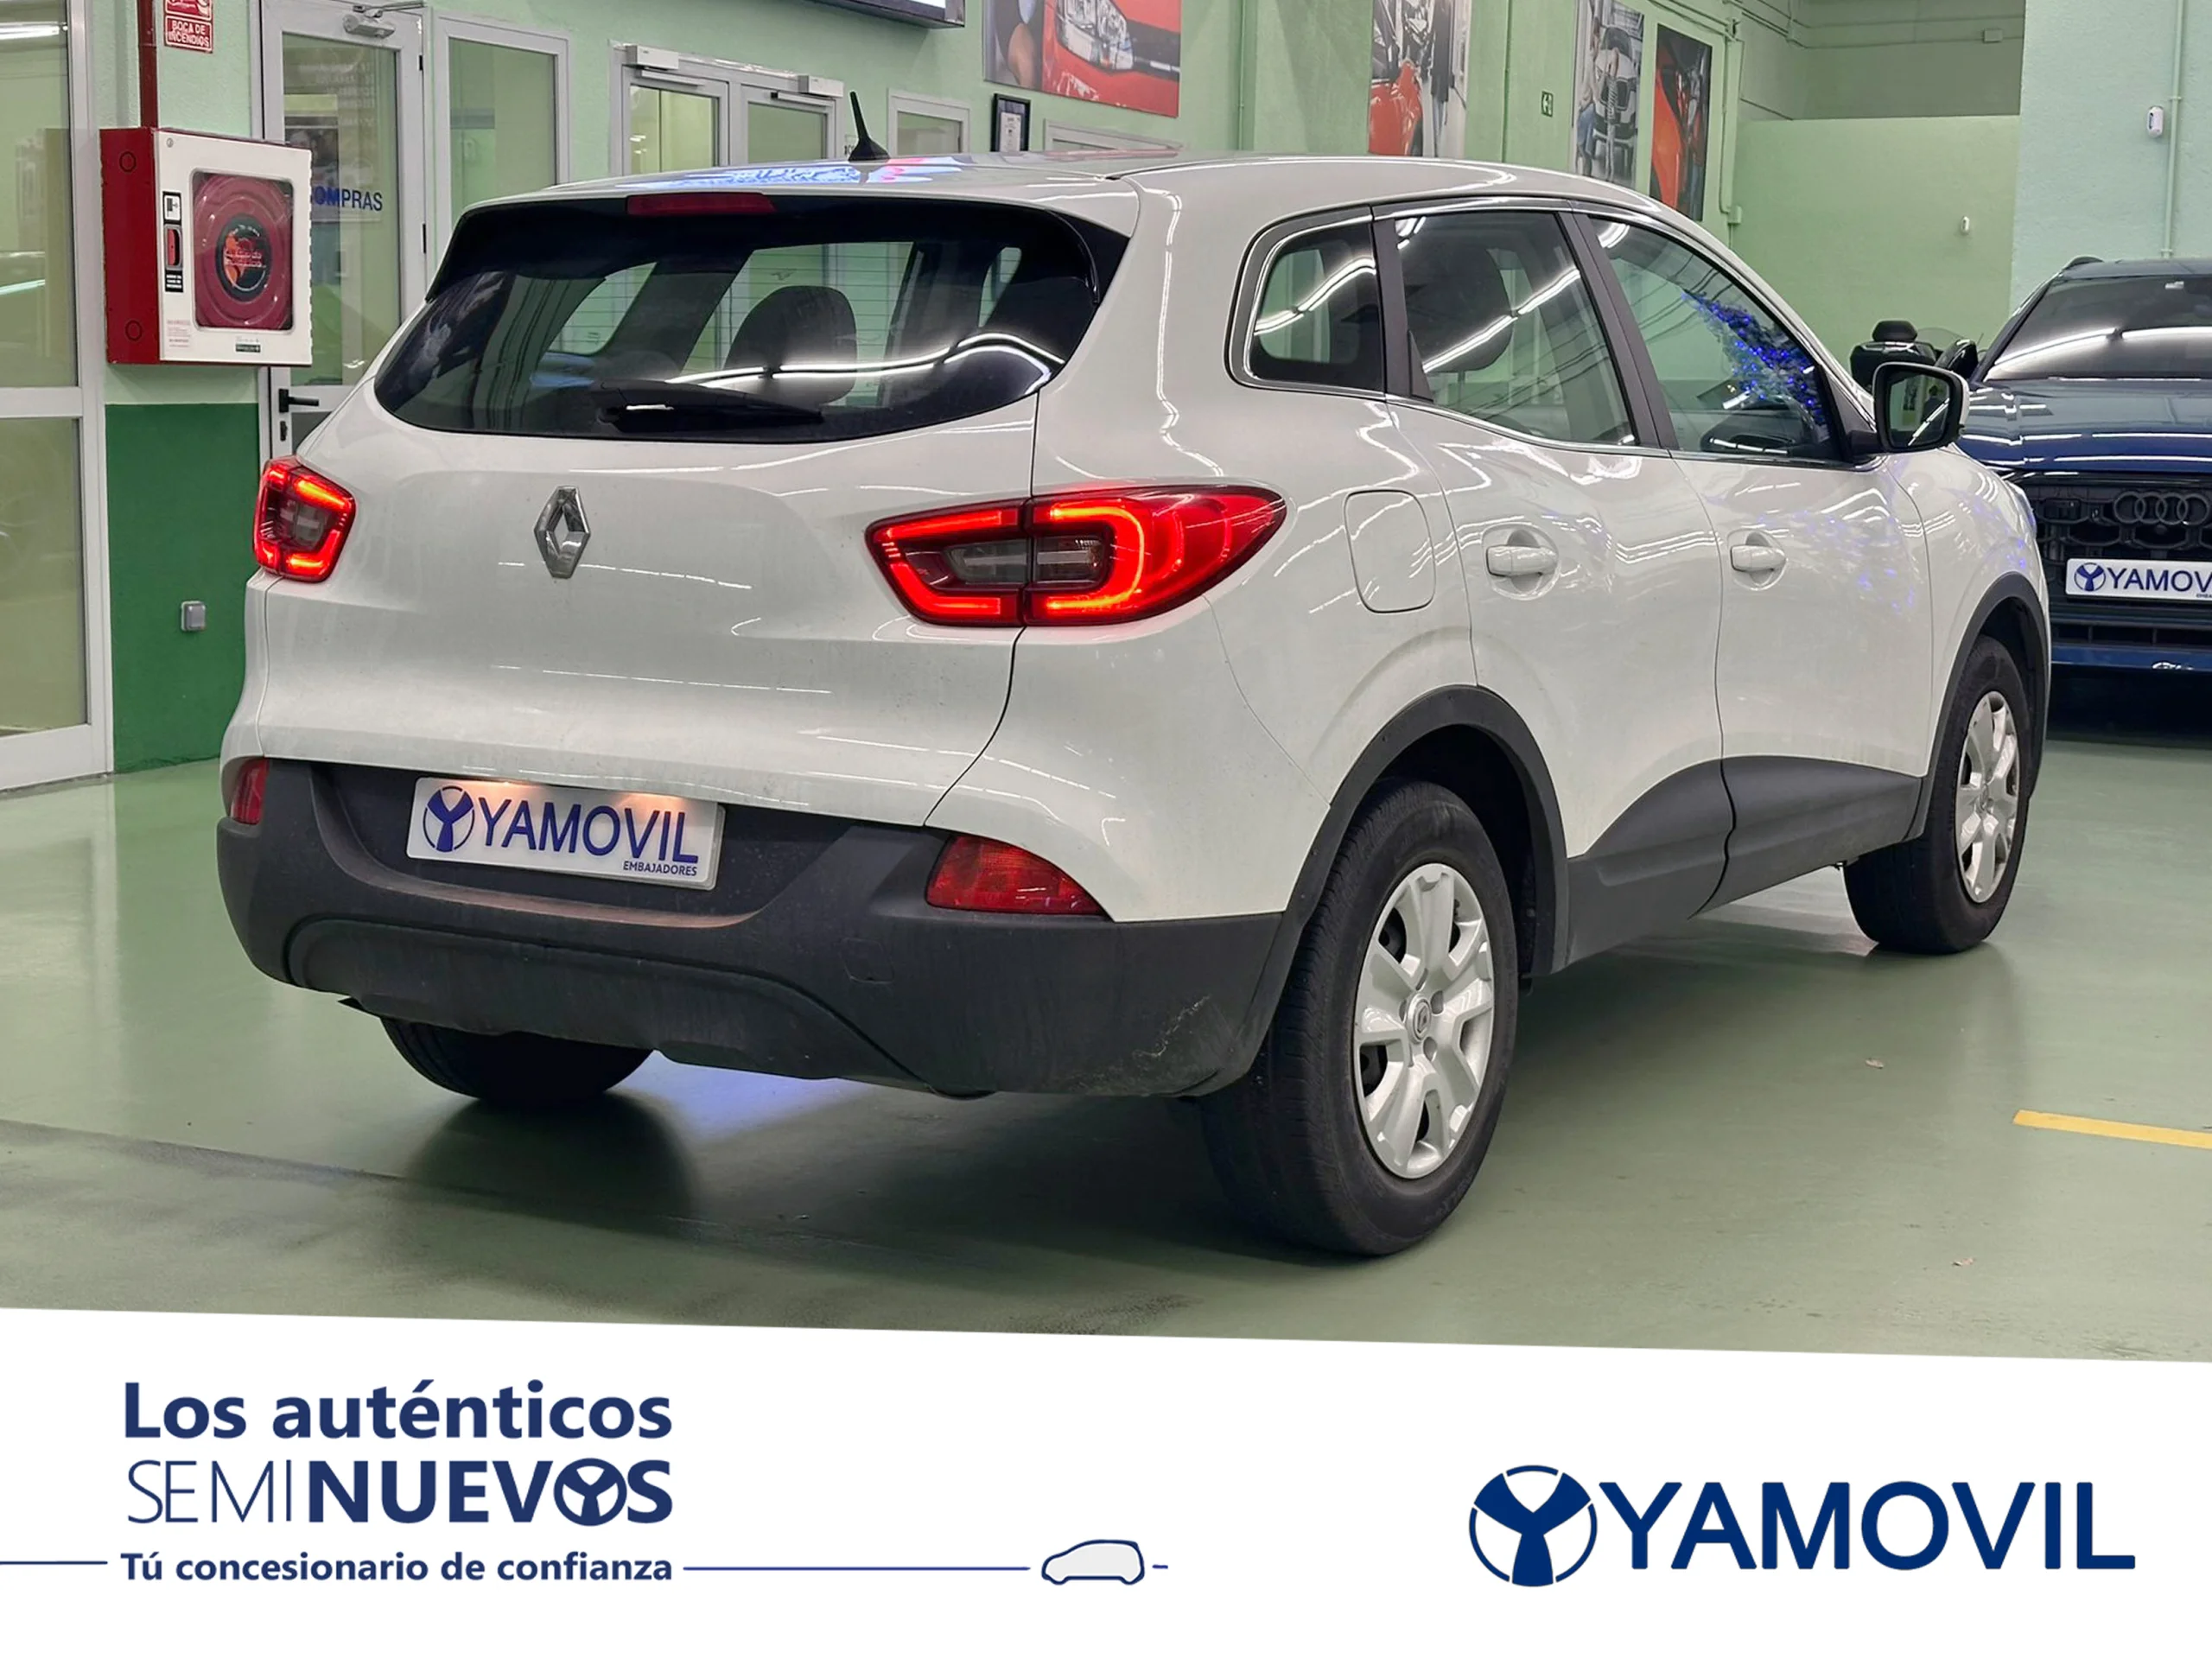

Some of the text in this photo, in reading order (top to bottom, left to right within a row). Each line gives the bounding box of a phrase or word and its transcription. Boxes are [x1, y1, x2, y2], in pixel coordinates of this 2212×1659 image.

[172, 20, 206, 35] BOCA DE
[168, 31, 209, 48] INCENDIOS
[312, 185, 383, 212] OMPRAS
[479, 797, 698, 864] YAMOVIL
[623, 860, 697, 876] EMBAJADORES
